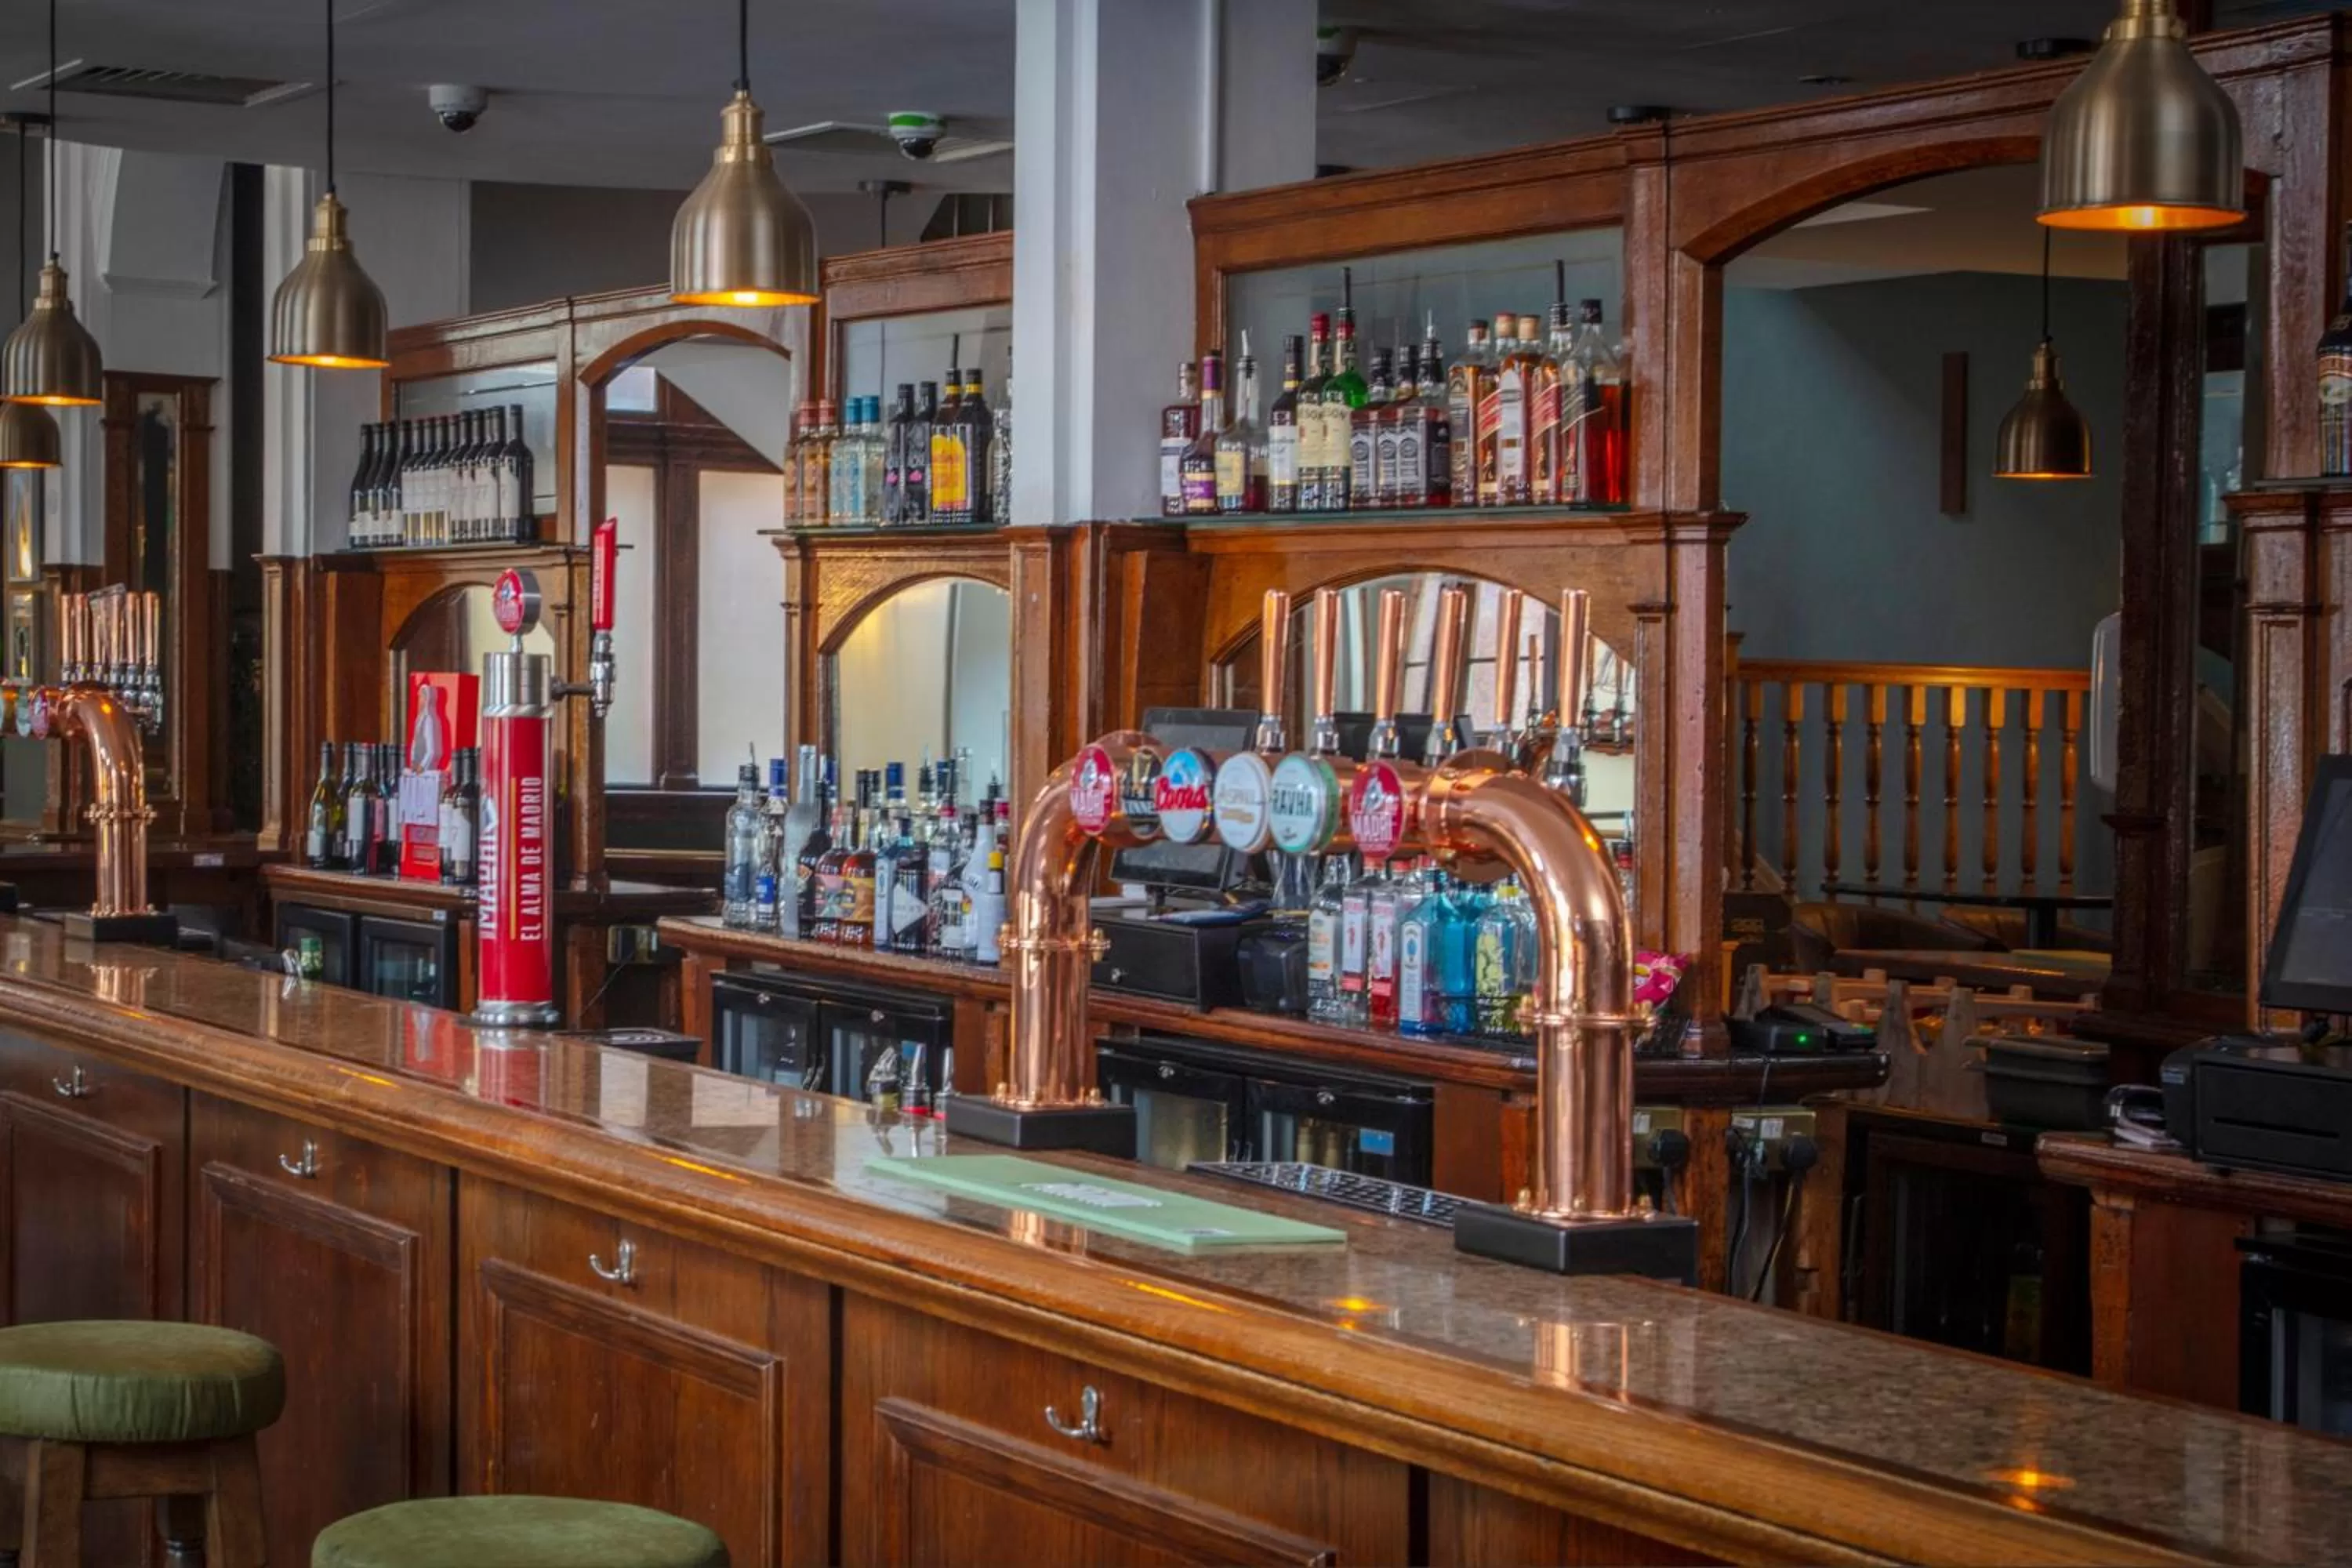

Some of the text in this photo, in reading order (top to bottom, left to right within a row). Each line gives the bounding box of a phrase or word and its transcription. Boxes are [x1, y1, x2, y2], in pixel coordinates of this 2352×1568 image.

[1156, 776, 1207, 811] Coors
[1271, 789, 1314, 816] RAVHA
[521, 776, 542, 941] EL ALMA DE MADRID
